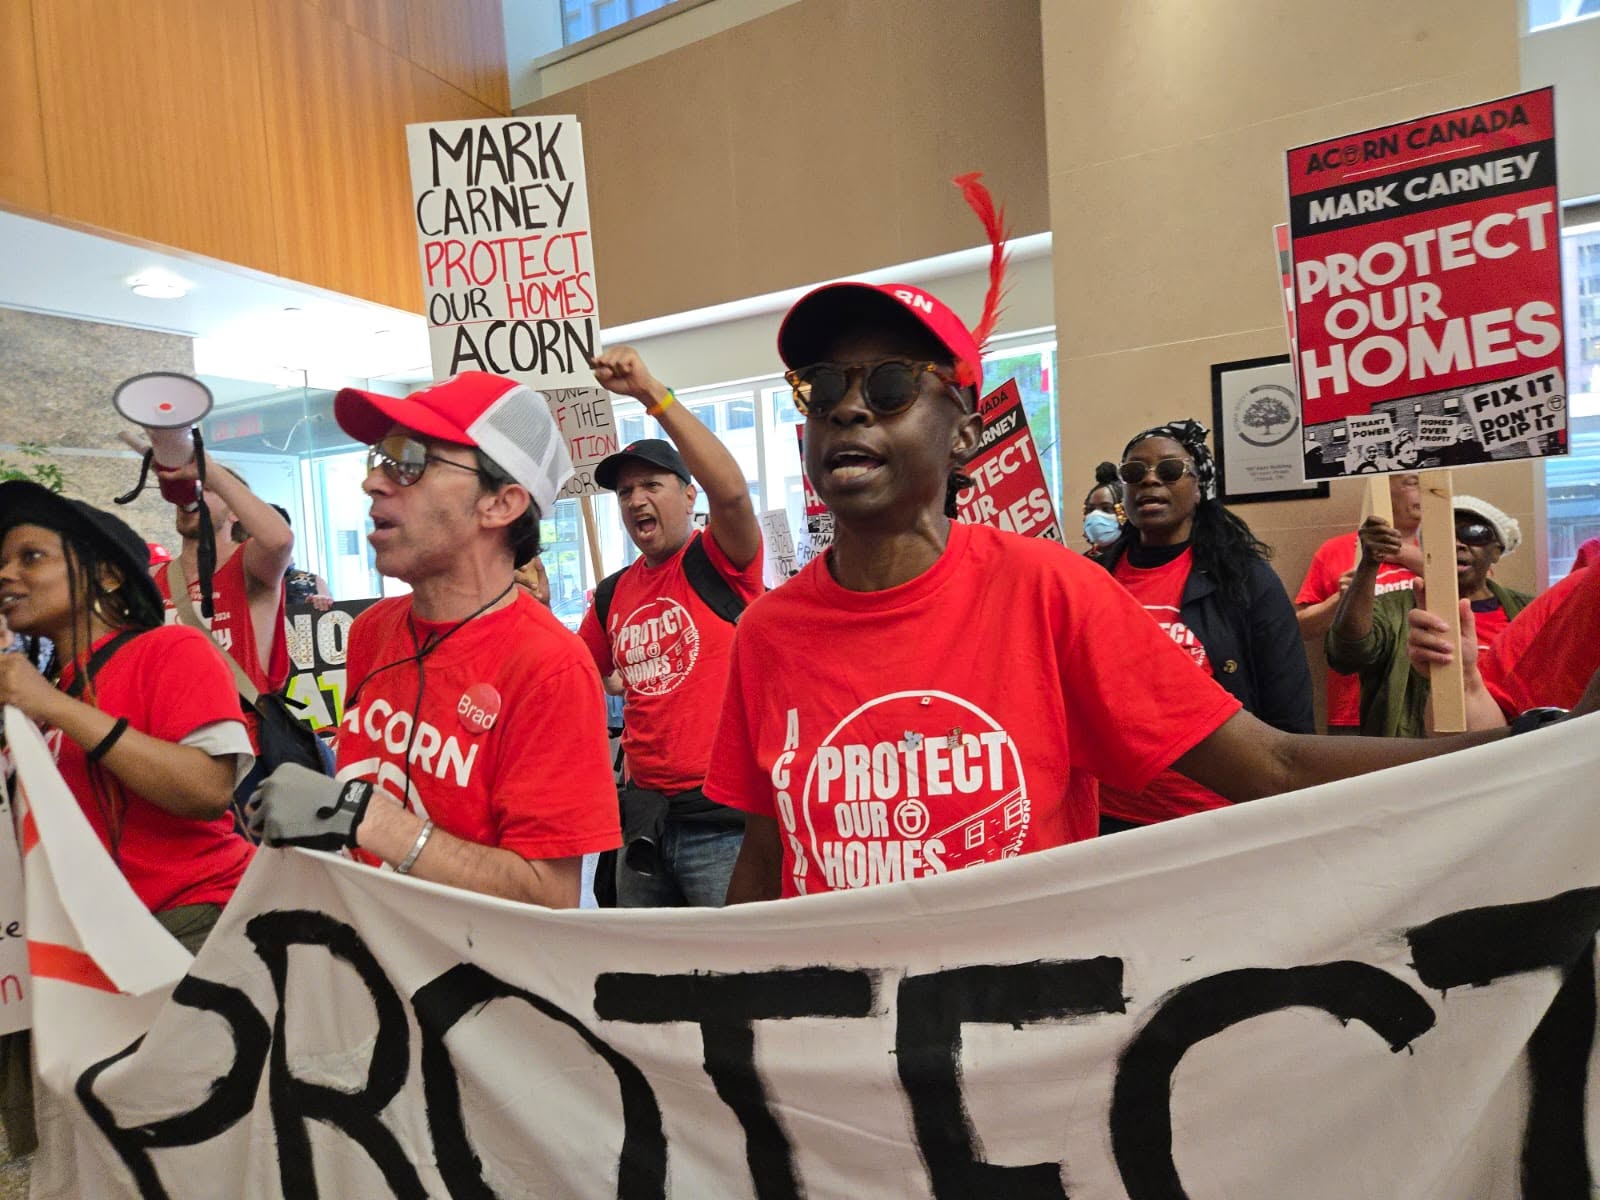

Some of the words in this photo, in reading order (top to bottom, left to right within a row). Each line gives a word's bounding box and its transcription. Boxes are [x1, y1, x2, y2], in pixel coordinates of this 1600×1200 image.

[1406, 104, 1529, 149] CANADA
[428, 121, 567, 187] MARK
[416, 182, 575, 236] CARNEY
[1309, 182, 1400, 225] MARK
[1404, 152, 1540, 202] CARNEY
[424, 231, 588, 288] PROTECT
[1296, 202, 1554, 304] PROTECT
[429, 287, 493, 326] OUR
[505, 271, 595, 319] HOMES
[1324, 282, 1448, 340] OUR
[449, 317, 597, 376] ACORN
[1301, 301, 1562, 400] HOMES
[570, 399, 609, 428] THE
[1473, 383, 1519, 413] FIX
[1527, 374, 1554, 398] IT
[1350, 418, 1386, 429] TENANT
[1352, 427, 1391, 439] POWER
[1419, 435, 1451, 443] PROFIT
[1420, 427, 1448, 435] OVER
[1480, 403, 1545, 433] DON'T
[1483, 423, 1532, 446] FLIP
[1536, 414, 1556, 431] IT
[285, 610, 354, 670] NO
[619, 605, 683, 651] PROTECT
[624, 654, 672, 686] HOMES
[625, 645, 647, 664] OUR
[457, 693, 498, 730] Brad
[816, 730, 1007, 803] PROTECT
[834, 801, 890, 839] OUR
[823, 837, 948, 889] HOMES
[76, 886, 1600, 1200] PROTECT
